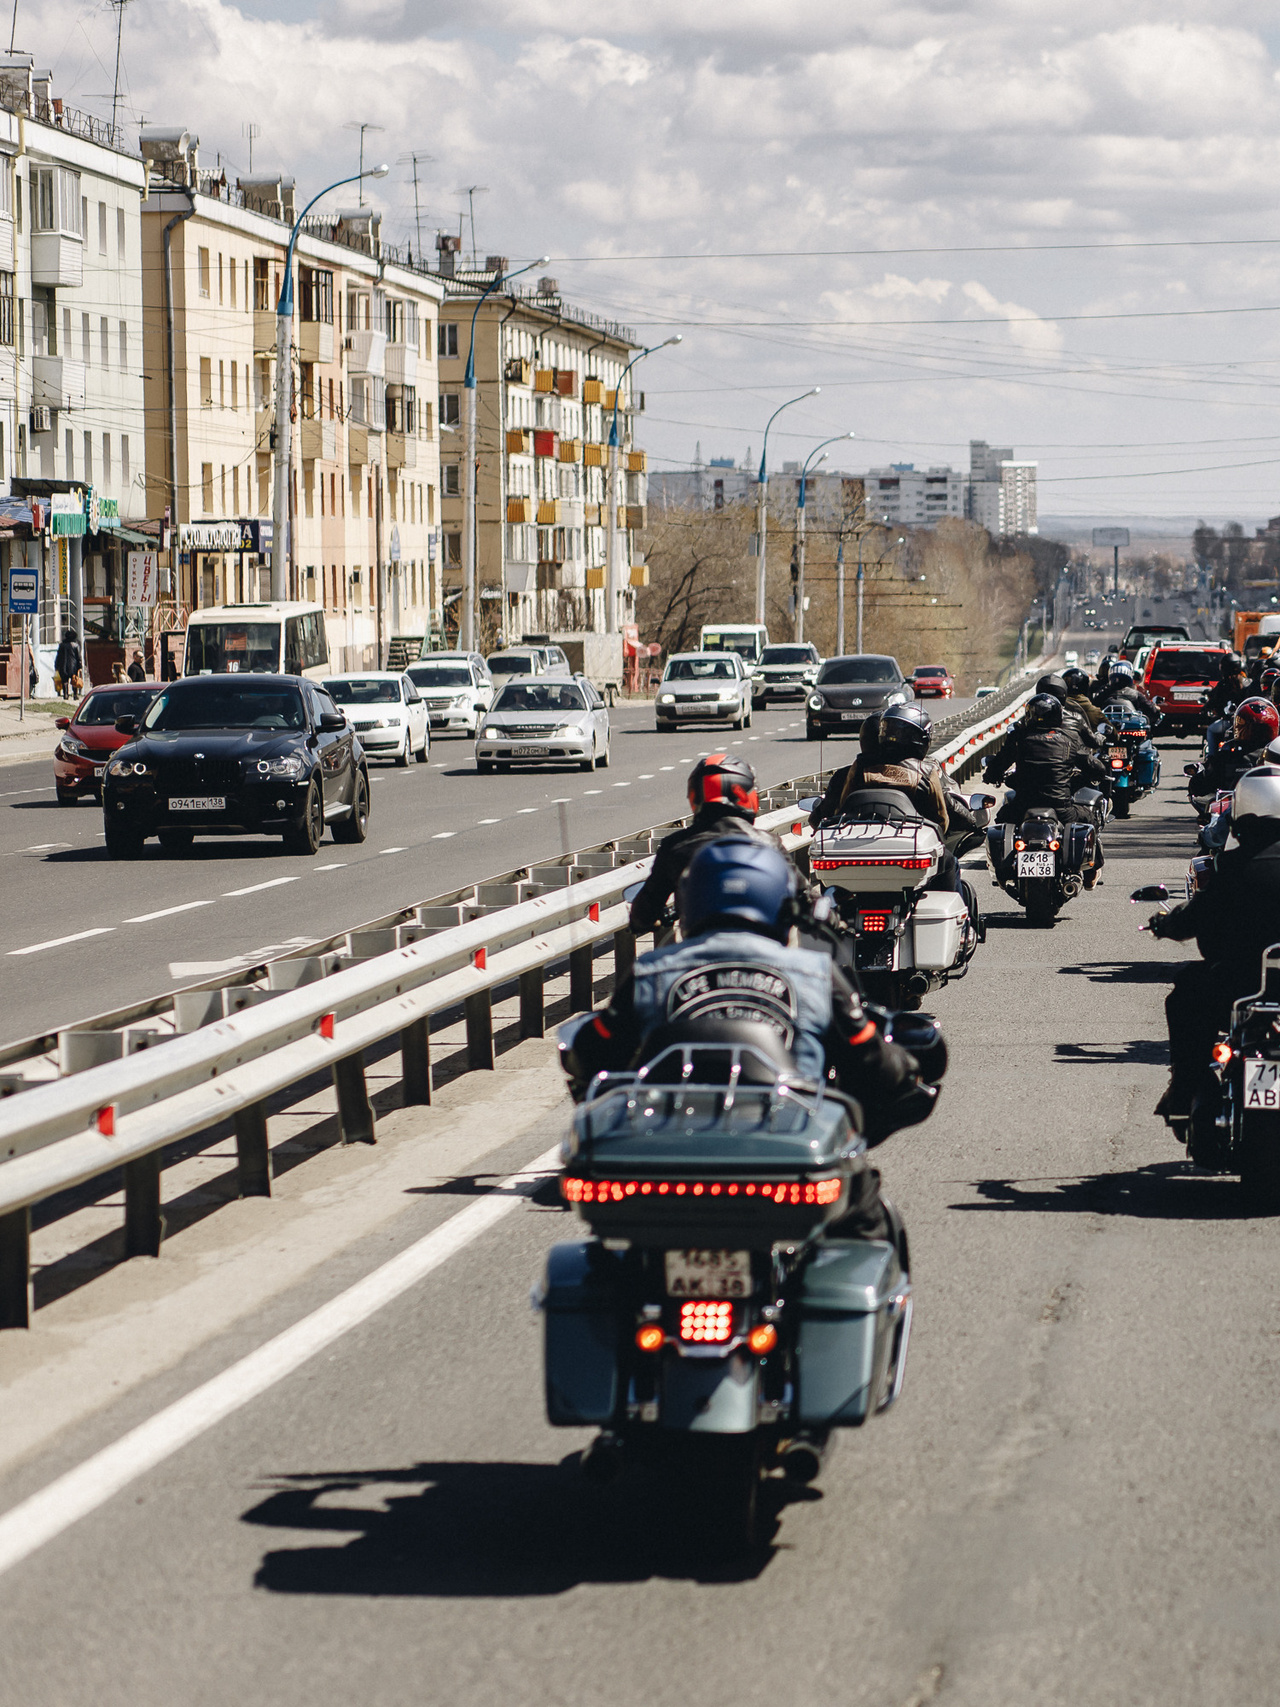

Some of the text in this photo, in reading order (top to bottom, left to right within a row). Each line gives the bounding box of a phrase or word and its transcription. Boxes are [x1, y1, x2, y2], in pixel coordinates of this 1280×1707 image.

[140, 555, 152, 603] ЦВЕТЫ
[229, 661, 239, 673] 16
[171, 798, 223, 809] О941ЕК 138
[1023, 853, 1049, 863] 2618
[1020, 866, 1052, 876] АК 38
[676, 970, 787, 1001] LIFE MEMBER
[1248, 1088, 1277, 1106] АВ
